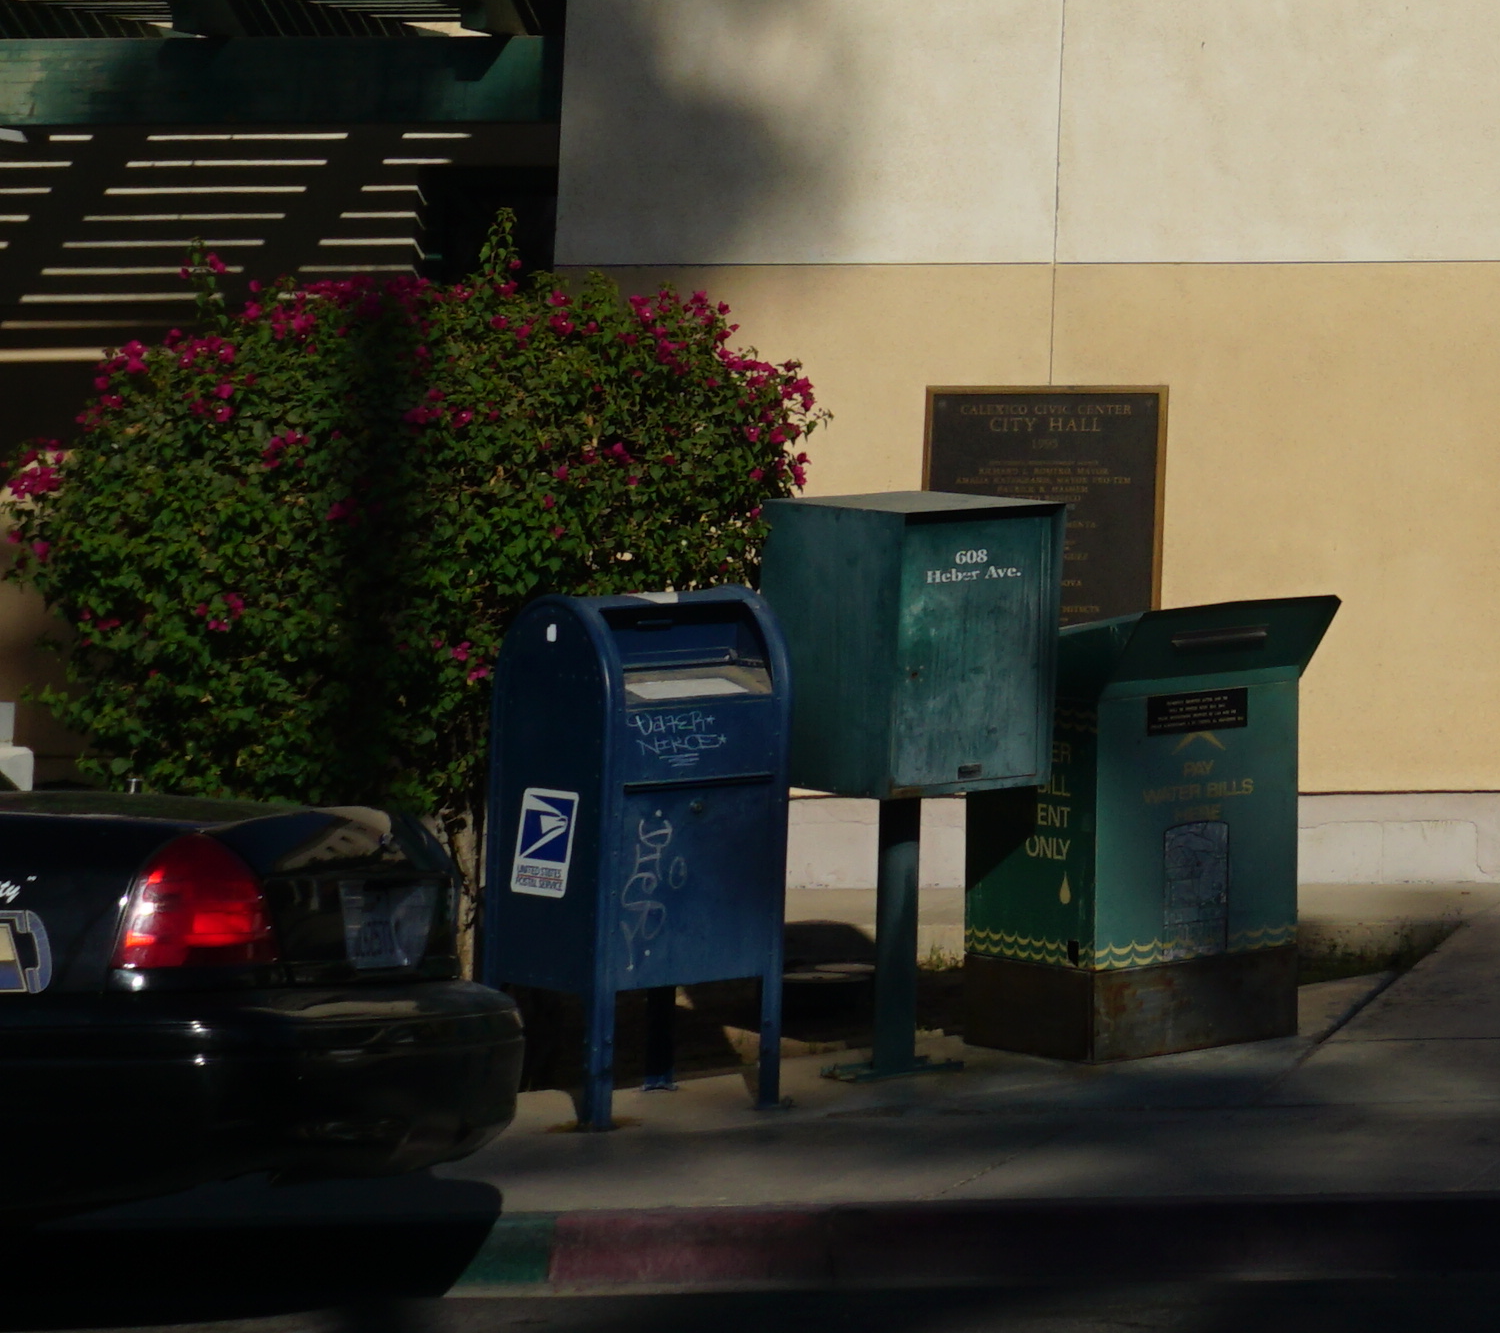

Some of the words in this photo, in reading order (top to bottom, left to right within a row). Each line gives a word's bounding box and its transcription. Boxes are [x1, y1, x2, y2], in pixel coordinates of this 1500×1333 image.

[960, 404, 1028, 416] CALEXICO
[1034, 404, 1070, 416] CIVIC
[1077, 404, 1133, 416] CENTER
[988, 417, 1038, 433] CITY
[1048, 417, 1102, 433] HALL
[955, 548, 988, 565] 608
[926, 569, 980, 584] Heber
[985, 565, 1022, 580] Ave.
[1183, 759, 1215, 777] PAY
[1206, 778, 1255, 798] BILLS
[1025, 834, 1072, 860] ONLY
